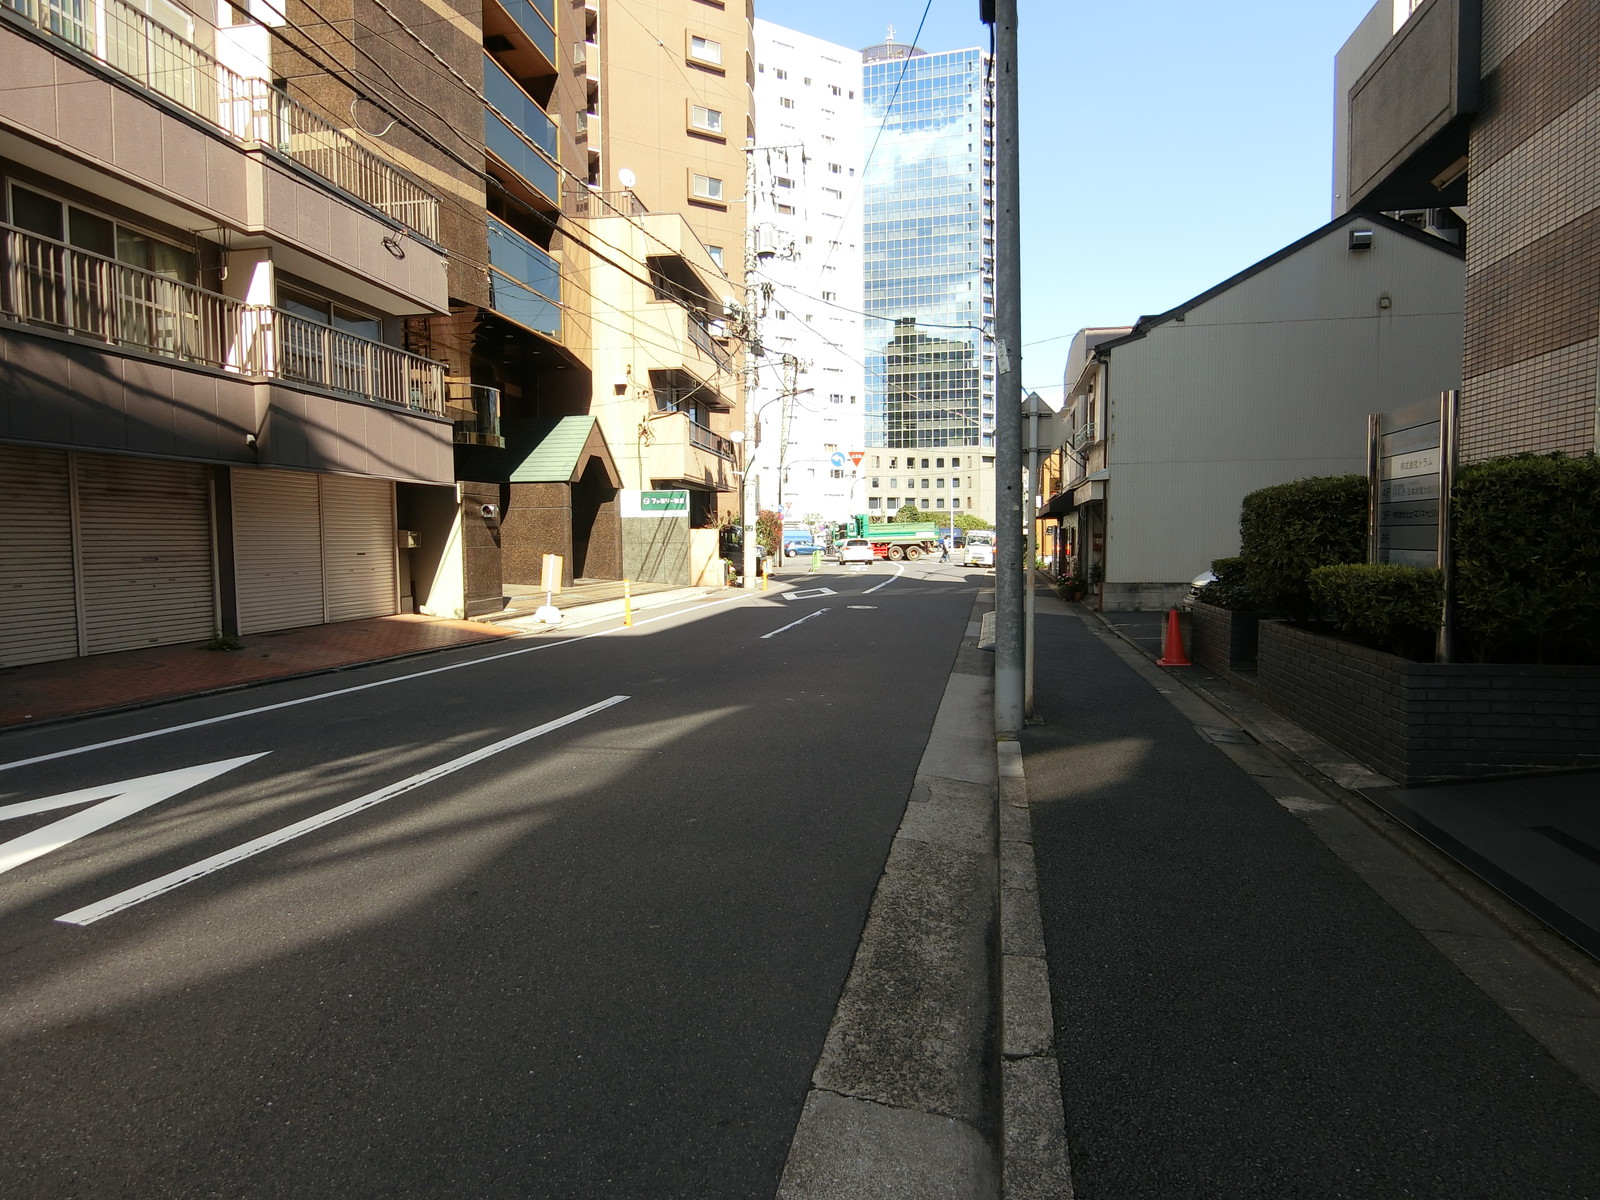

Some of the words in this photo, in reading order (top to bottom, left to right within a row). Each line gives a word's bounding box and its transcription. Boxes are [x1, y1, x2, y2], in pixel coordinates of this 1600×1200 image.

[1400, 457, 1433, 470] 株式会社トラム
